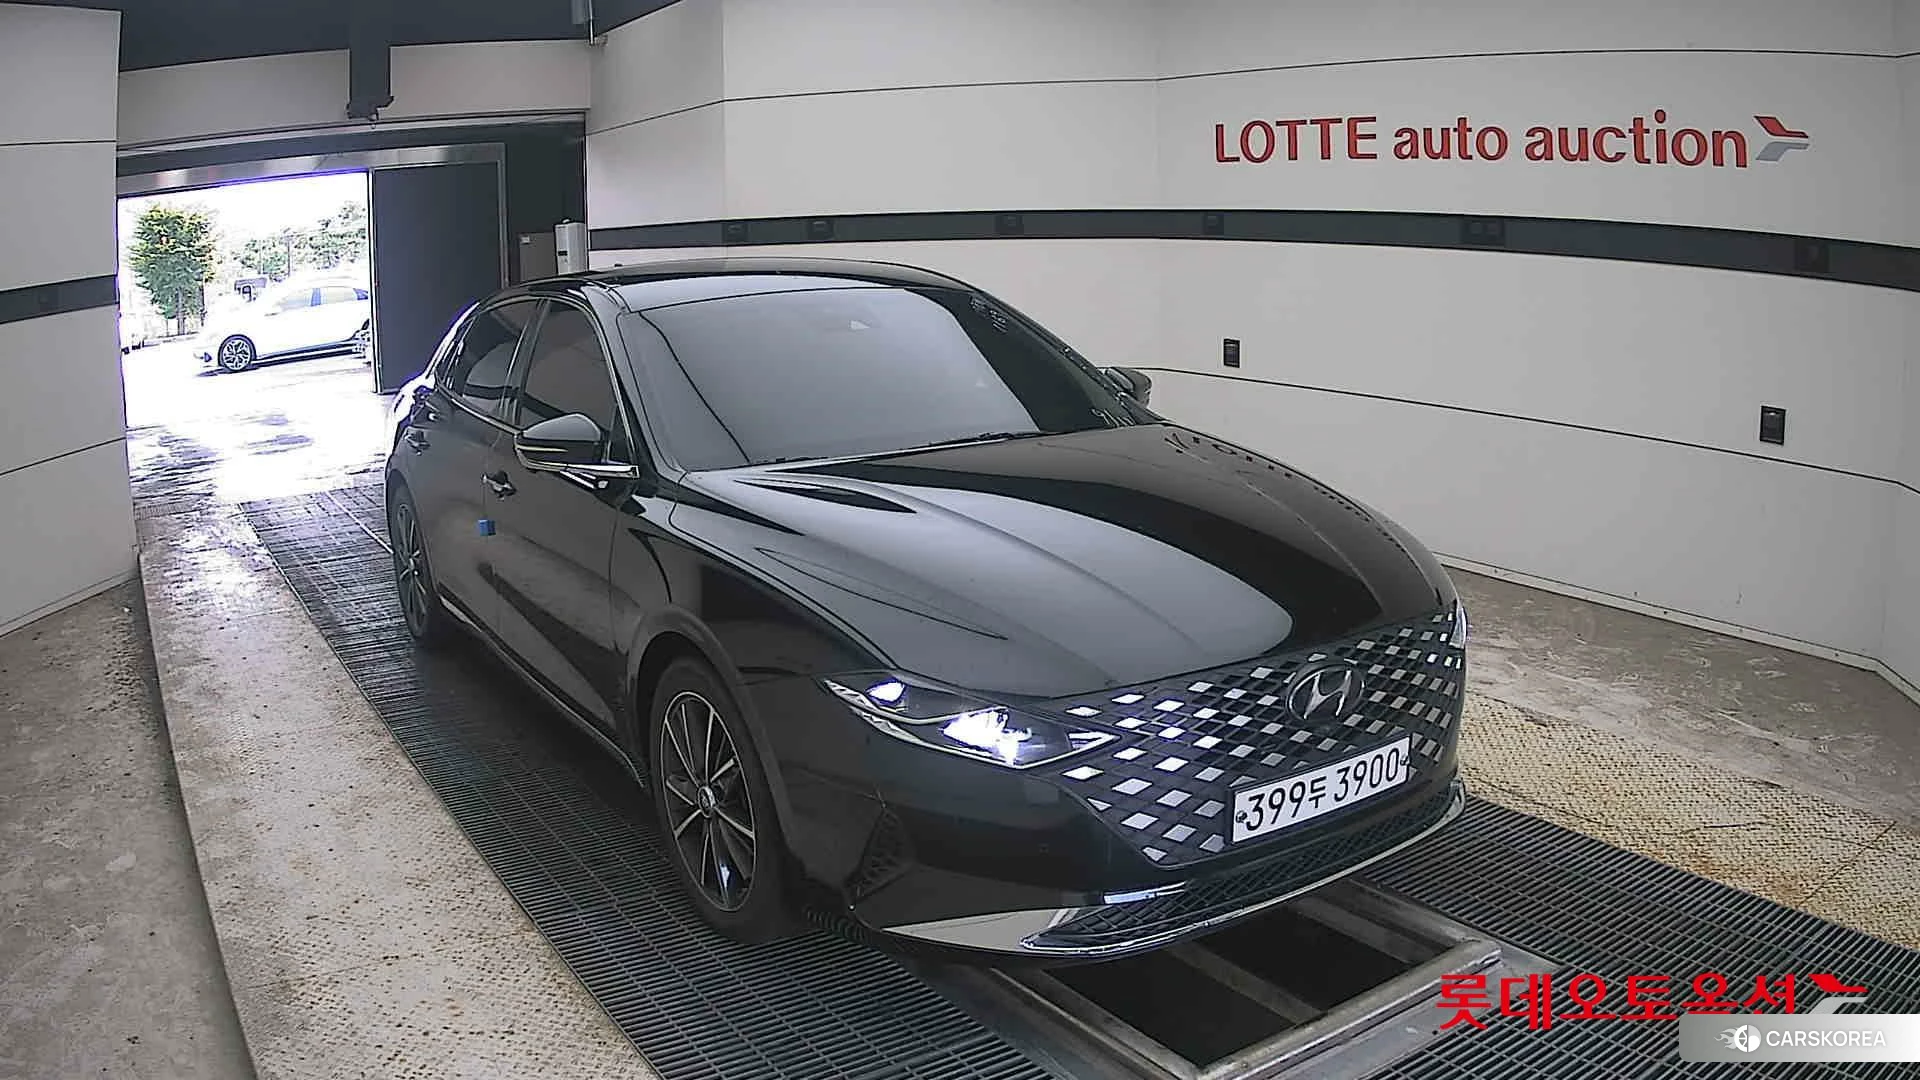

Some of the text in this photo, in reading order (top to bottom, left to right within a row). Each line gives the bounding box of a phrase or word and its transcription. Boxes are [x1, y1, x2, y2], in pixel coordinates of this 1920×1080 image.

[1215, 110, 1749, 168] LOTTE auto auction
[1246, 748, 1400, 831] 399두 3900
